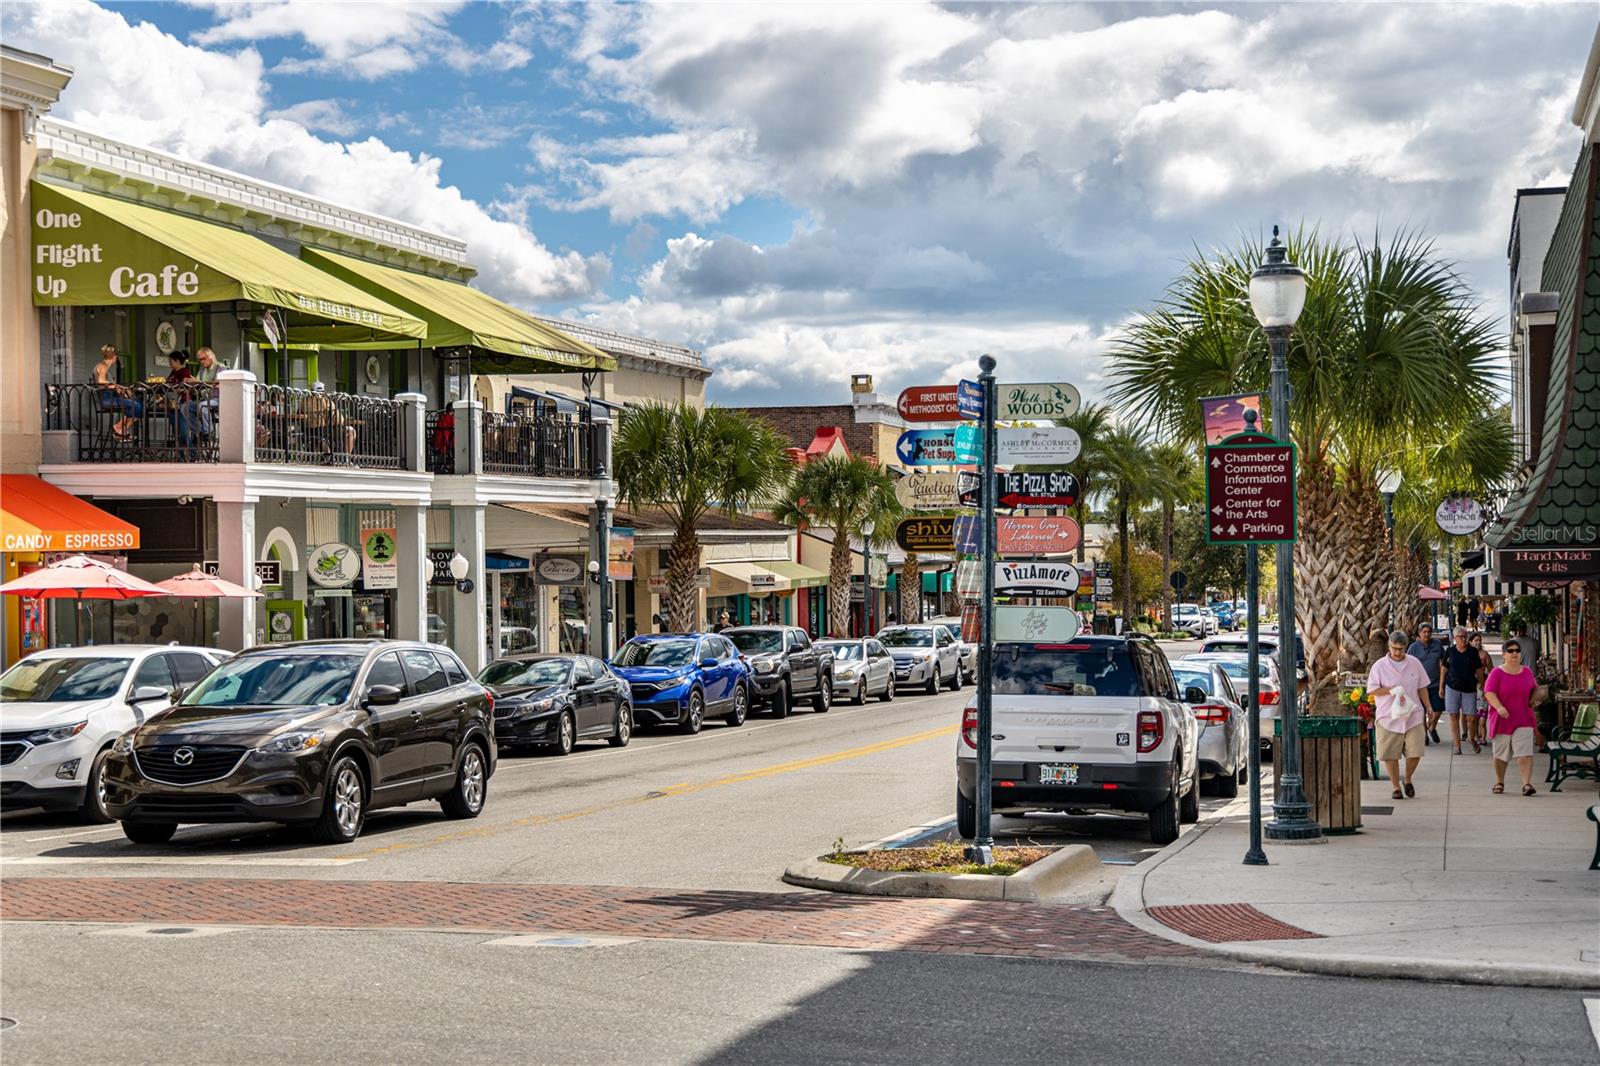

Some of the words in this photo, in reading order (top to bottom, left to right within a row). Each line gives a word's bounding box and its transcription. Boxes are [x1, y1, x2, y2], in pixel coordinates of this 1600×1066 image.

[36, 208, 81, 228] One
[36, 243, 102, 268] Flight
[36, 275, 67, 298] Up
[109, 264, 199, 298] Café
[920, 393, 937, 402] FIRST
[938, 392, 958, 401] UNITE
[909, 404, 945, 414] METHODIST
[945, 404, 960, 412] CHU
[1007, 403, 1065, 415] WOODS
[923, 448, 935, 459] Pet
[936, 448, 956, 461] Supp
[1224, 452, 1275, 463] Chamber
[1278, 451, 1290, 462] of
[1224, 464, 1285, 473] Commerce
[1003, 473, 1020, 493] THE
[1022, 473, 1046, 492] PIZZA
[1049, 472, 1073, 492] SHOP
[1225, 474, 1287, 484] Information
[1225, 485, 1262, 496] Center
[1225, 498, 1264, 509] Center
[1266, 499, 1282, 508] for
[1225, 510, 1243, 519] the
[1245, 509, 1268, 519] Arts
[1438, 510, 1480, 524] Simpson'
[906, 521, 952, 536] shiv
[1242, 523, 1284, 534] Parking
[5, 535, 52, 550] CANDY
[65, 533, 133, 549] ESPRESSO
[1514, 551, 1552, 561] Hand
[1553, 551, 1592, 560] Made
[1003, 565, 1070, 582] PizzAmore
[1537, 563, 1568, 572] Gifts
